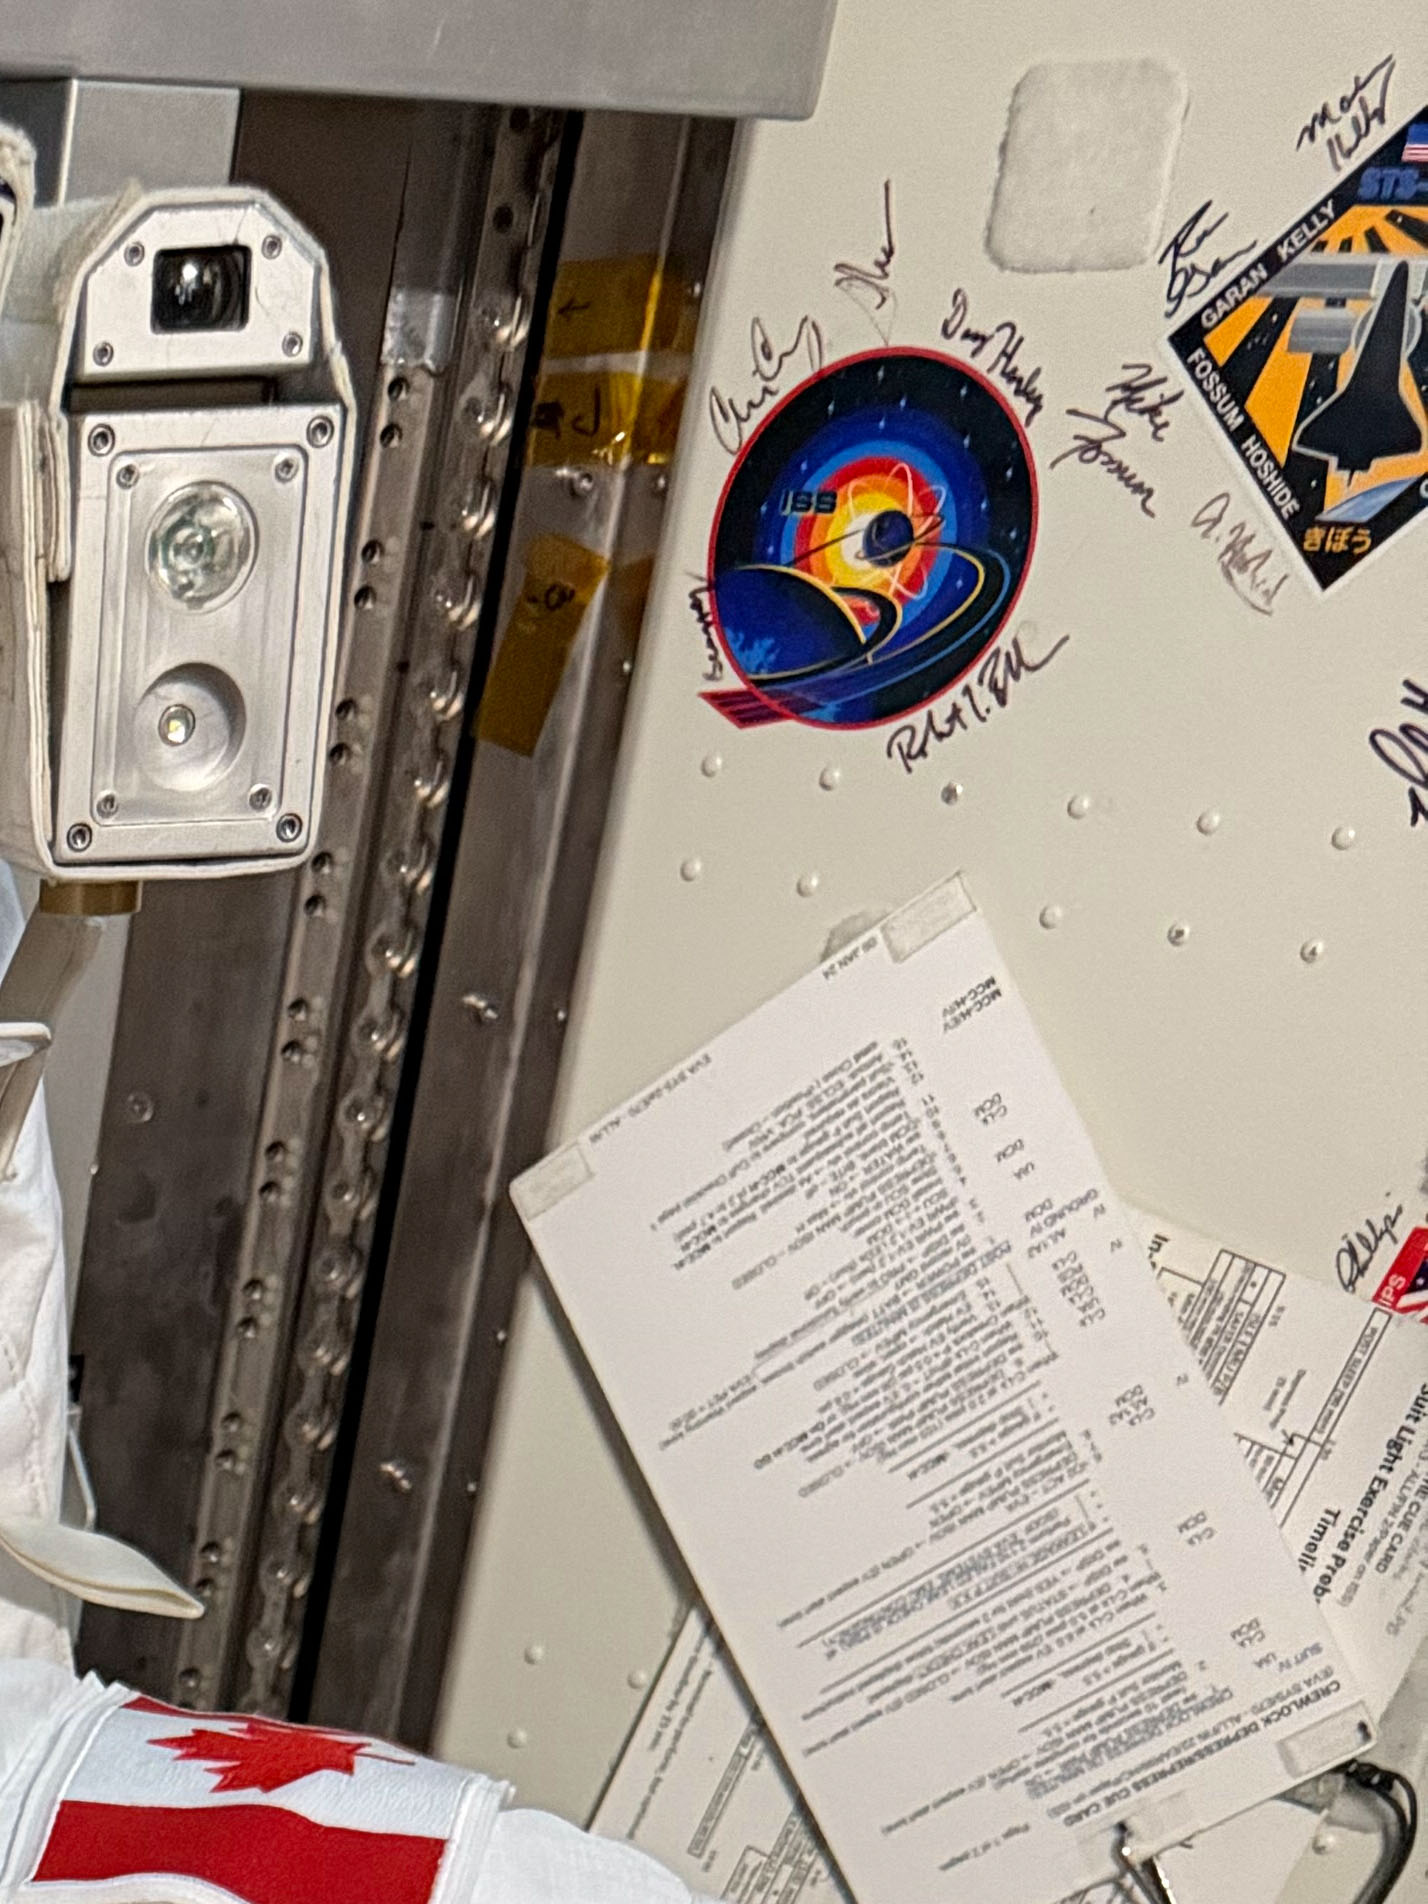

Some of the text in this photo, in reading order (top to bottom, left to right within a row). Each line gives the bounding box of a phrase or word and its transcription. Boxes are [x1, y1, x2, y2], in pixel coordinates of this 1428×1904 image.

[1201, 200, 1337, 330] GARAN KELLY
[1188, 347, 1301, 520] FOSSUM HOSHIDE
[1303, 526, 1373, 556] きぼう
[1375, 1422, 1414, 1475] Light
[1336, 1474, 1387, 1555] Exercise
[1374, 1499, 1420, 1575] CUE CARD
[1259, 1679, 1341, 1727] CREWLOCK
[1061, 1800, 1103, 1828] CARD
[1101, 1785, 1131, 1807] CUE
